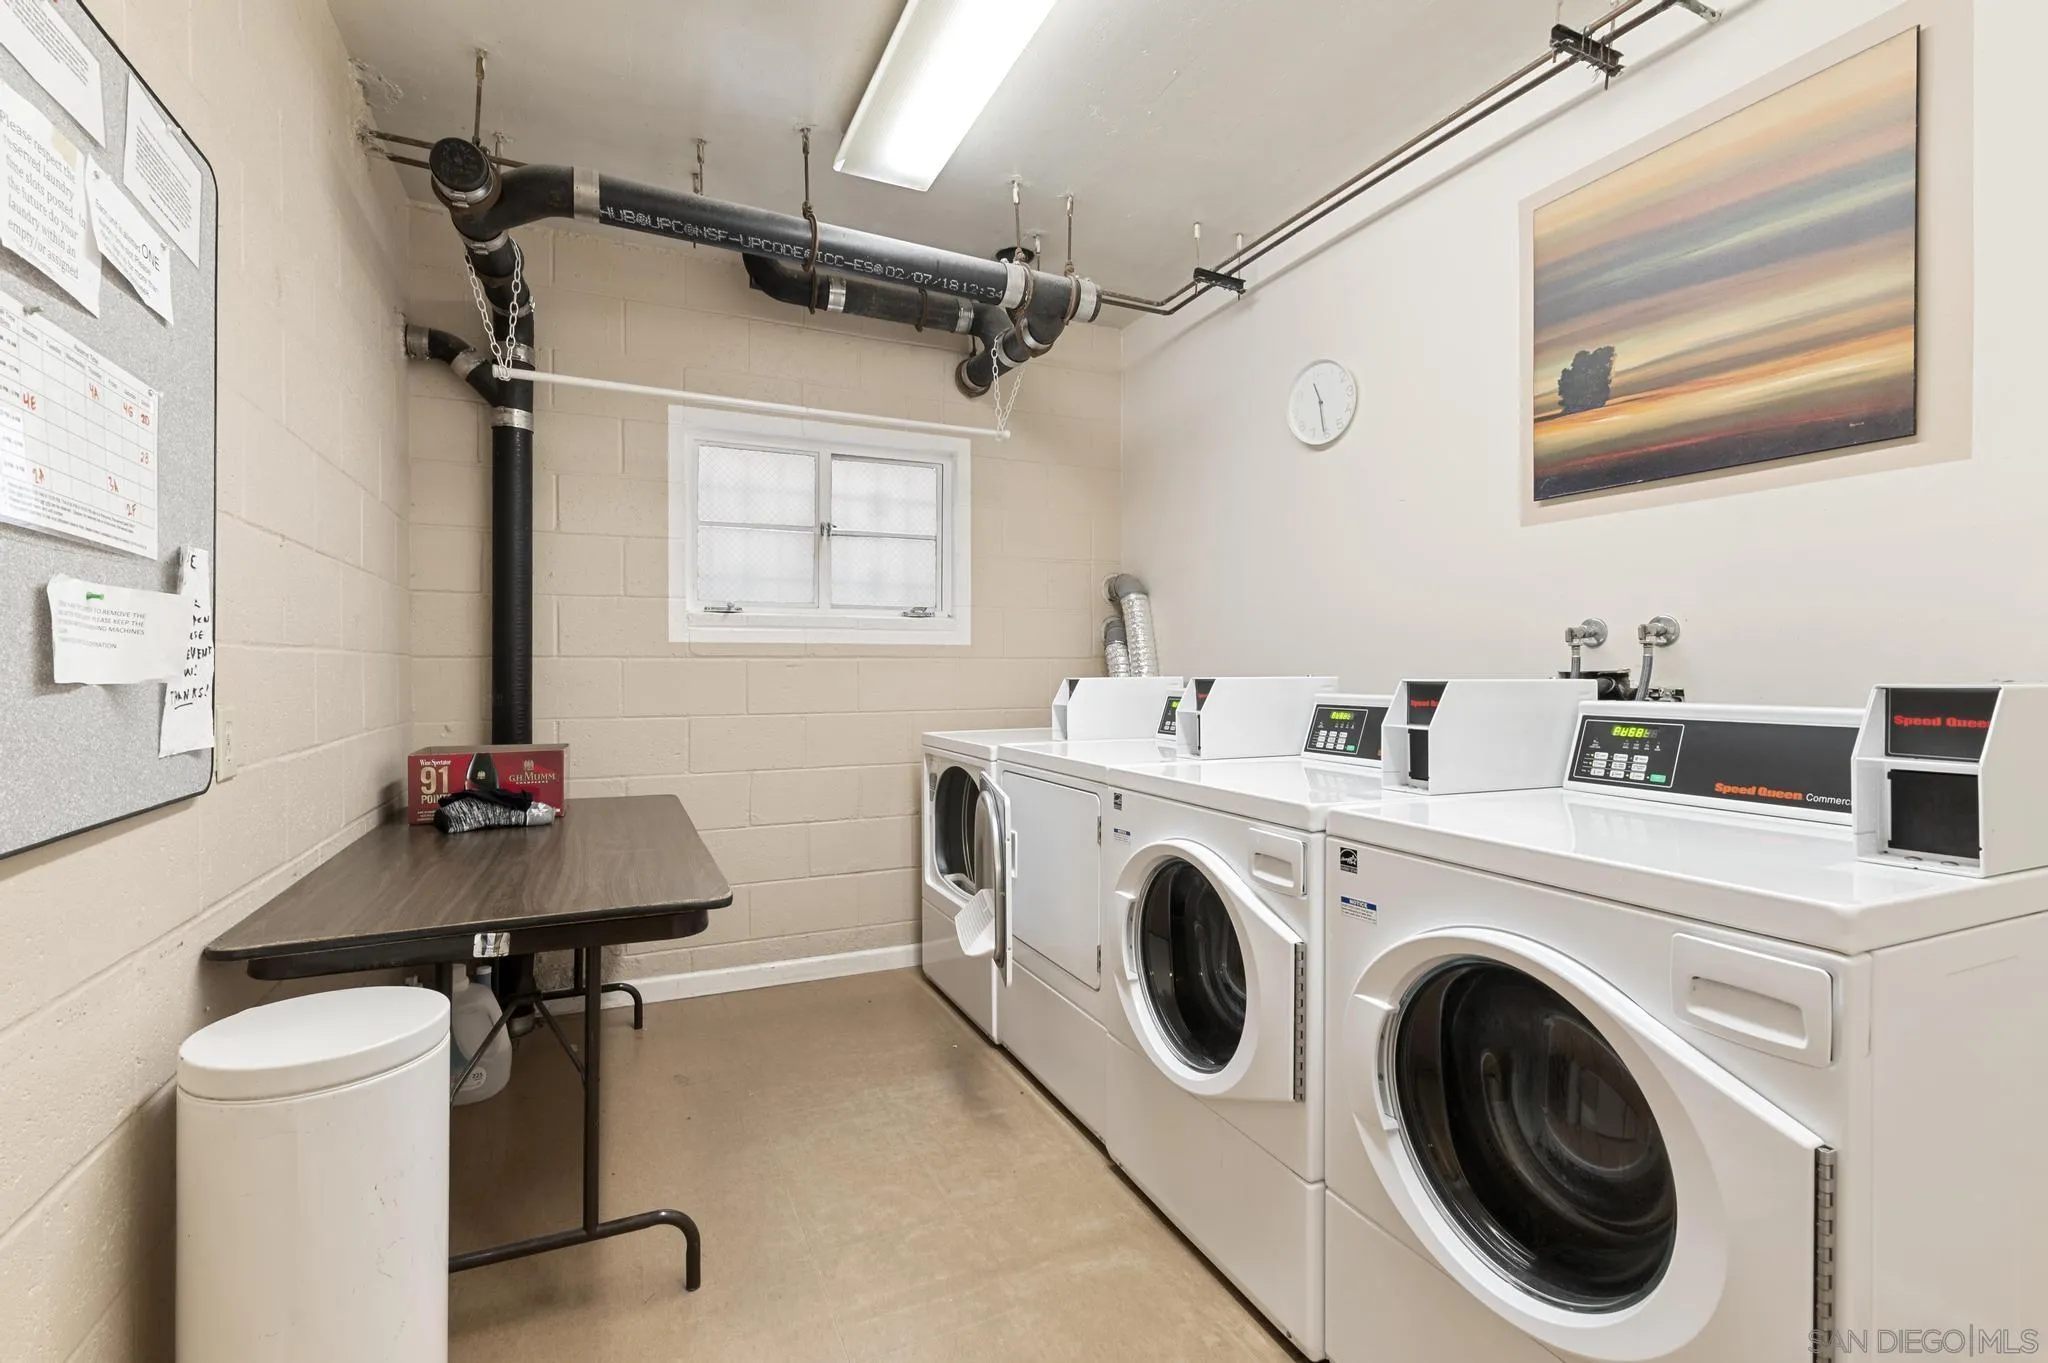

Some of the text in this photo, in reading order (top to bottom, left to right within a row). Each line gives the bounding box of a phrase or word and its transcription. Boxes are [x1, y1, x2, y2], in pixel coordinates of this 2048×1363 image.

[25, 172, 46, 196] slots
[43, 164, 74, 201] laundry
[8, 193, 40, 232] laundry
[41, 224, 66, 250] within
[66, 243, 77, 259] an
[48, 208, 60, 227] do
[60, 220, 80, 241] your
[47, 249, 79, 280] assigned
[142, 243, 160, 273] ONE
[108, 626, 145, 636] MACHINES
[1893, 715, 1991, 729] Speed Quee
[421, 766, 449, 795] 91
[1714, 782, 1852, 807] Speed Queen Commerc
[421, 794, 452, 804] POIN
